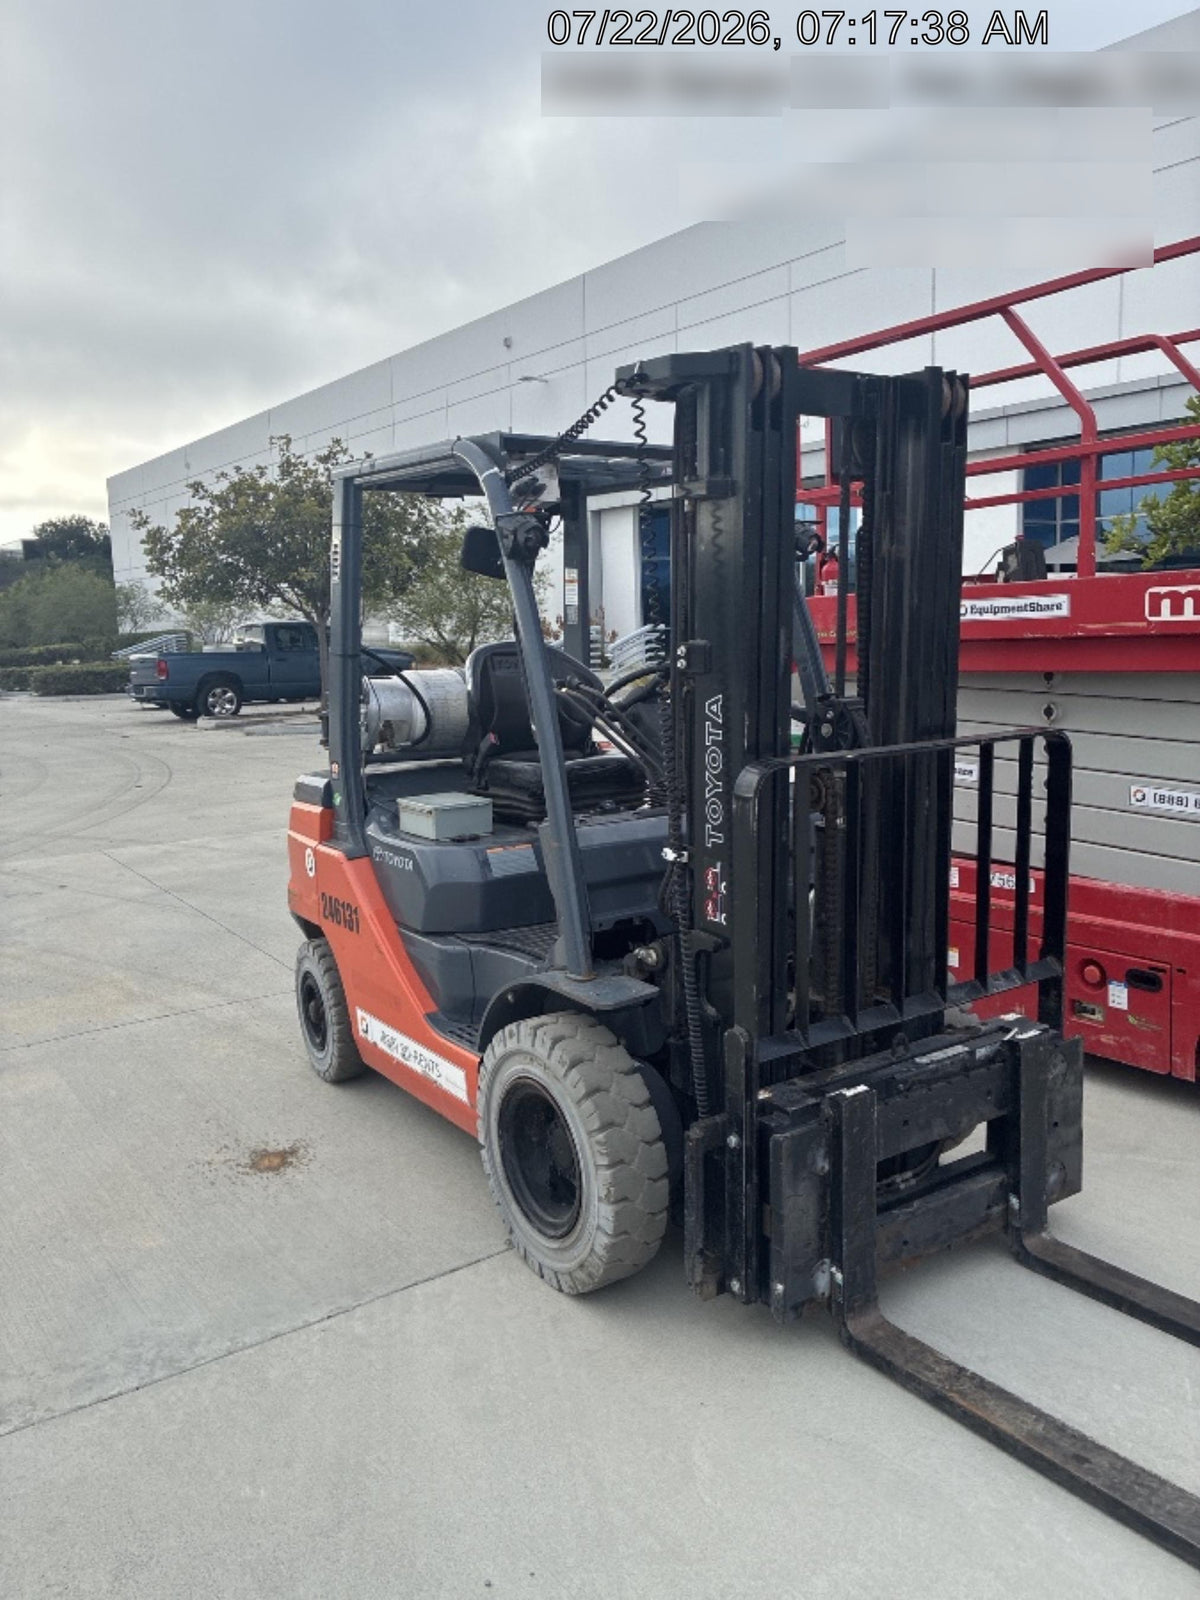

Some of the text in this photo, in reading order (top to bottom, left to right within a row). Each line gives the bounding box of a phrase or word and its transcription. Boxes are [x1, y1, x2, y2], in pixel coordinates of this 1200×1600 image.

[970, 602, 1063, 616] EquipmentShare
[705, 694, 724, 848] TOYOTA
[321, 892, 360, 935] 246131
